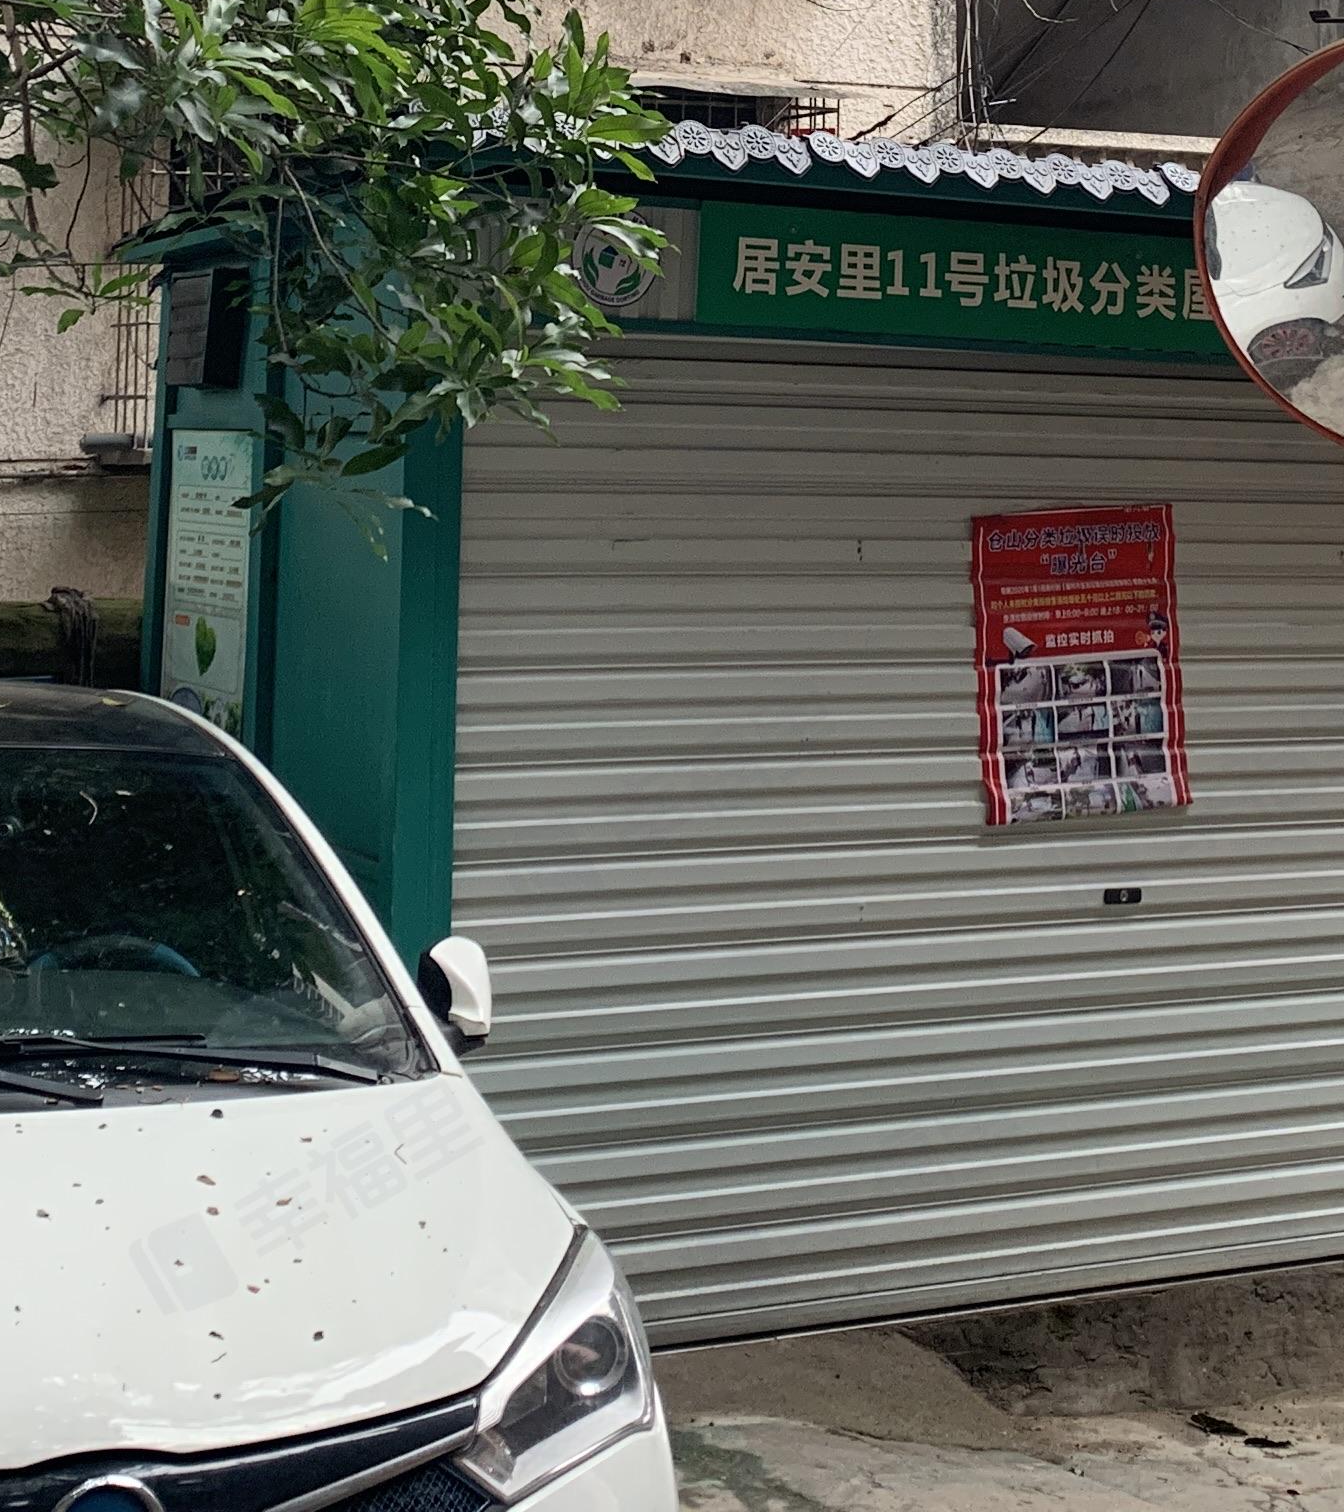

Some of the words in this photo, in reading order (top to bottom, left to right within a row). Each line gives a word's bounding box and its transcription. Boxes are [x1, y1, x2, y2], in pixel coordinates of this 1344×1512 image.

[732, 236, 1215, 321] 居安里11号垃圾分类屋
